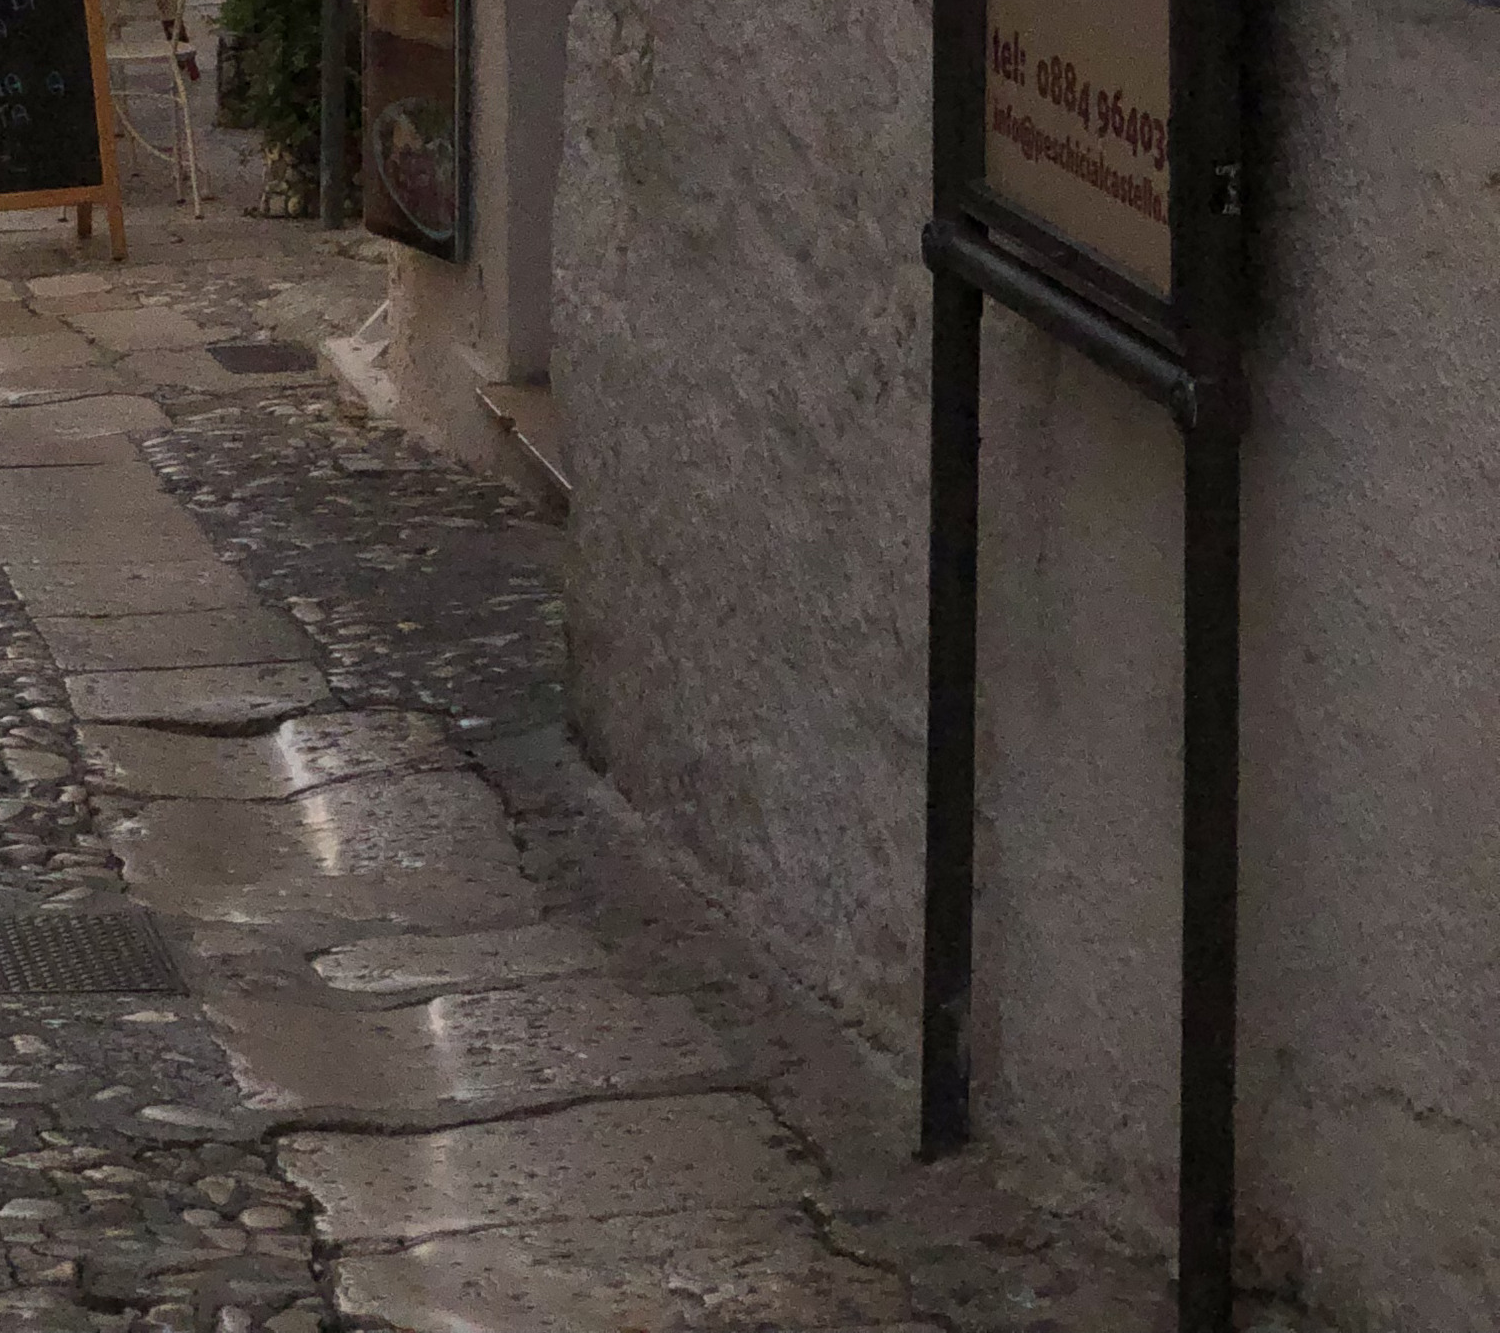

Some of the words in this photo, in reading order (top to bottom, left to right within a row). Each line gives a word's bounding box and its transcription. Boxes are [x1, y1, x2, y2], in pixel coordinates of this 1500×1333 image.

[993, 26, 1026, 88] tel:
[1037, 54, 1090, 132] 0884
[1097, 83, 1171, 172] 96403
